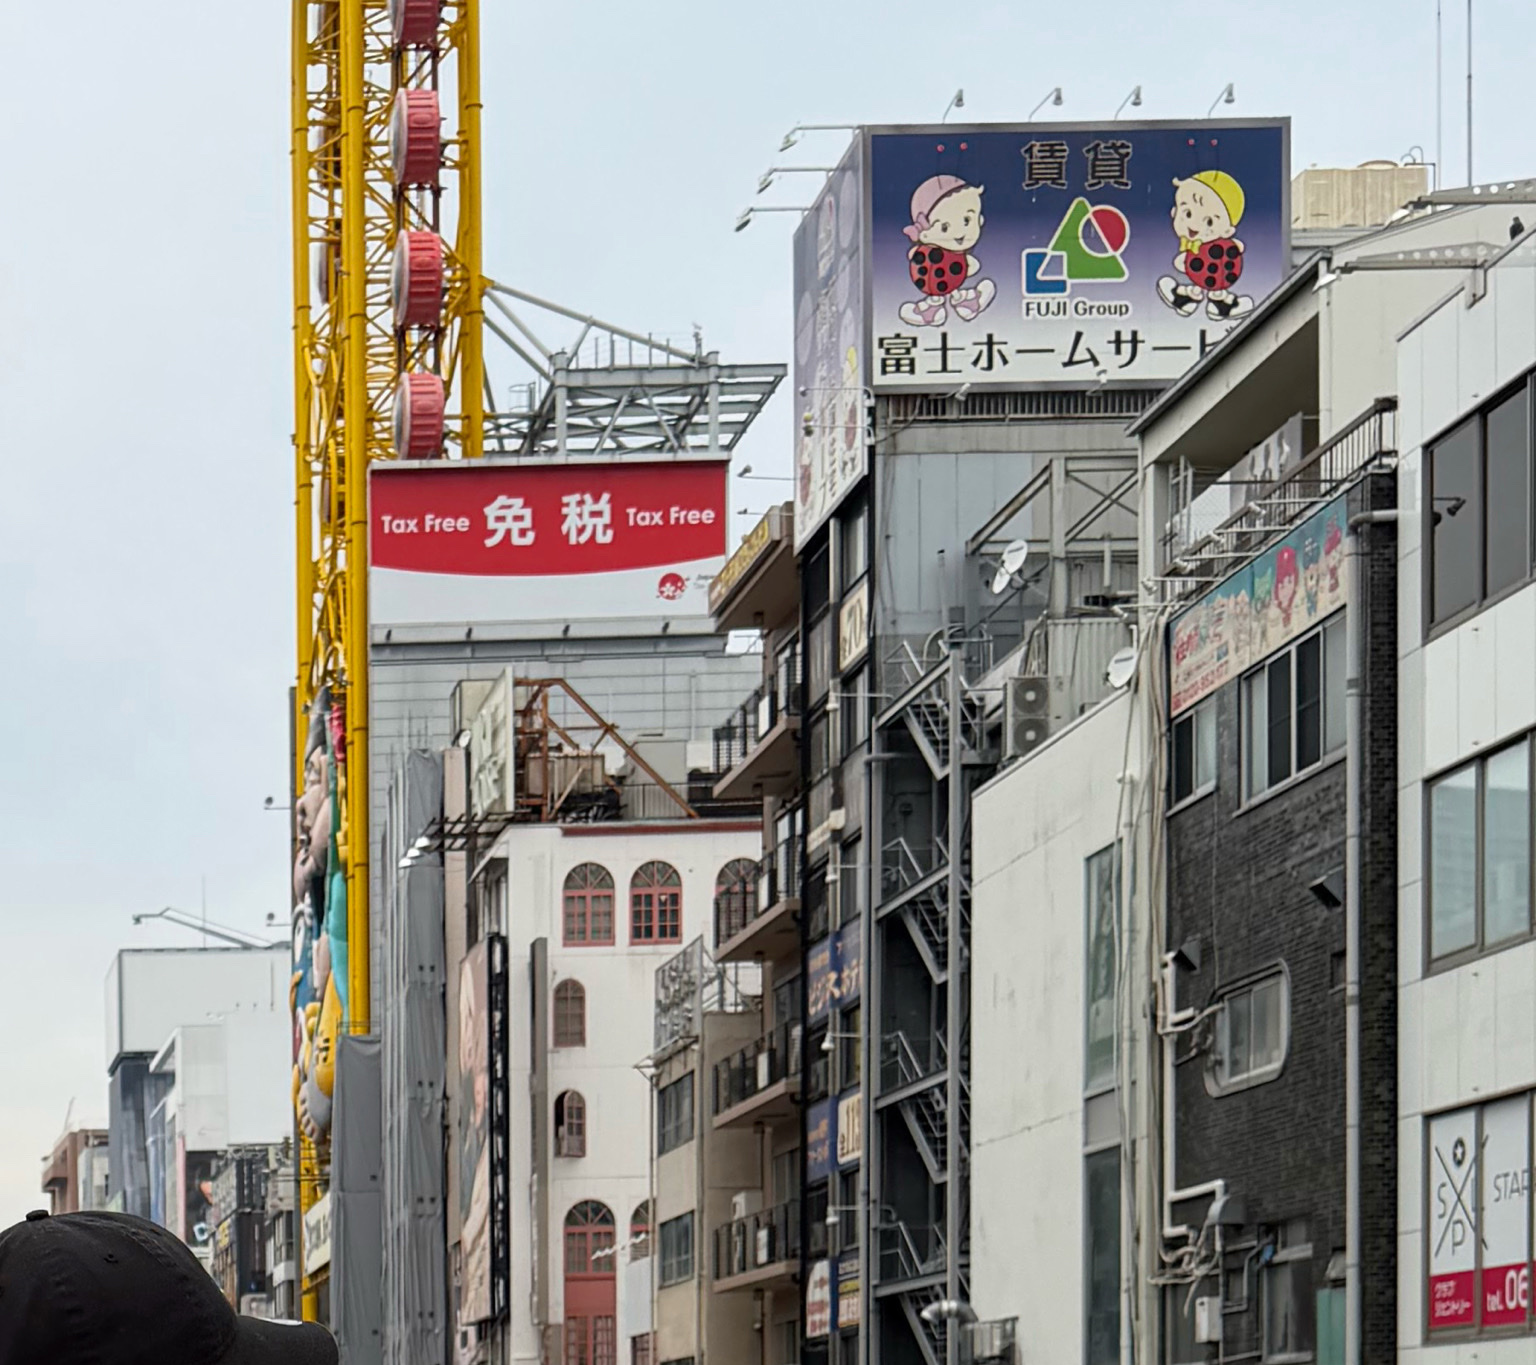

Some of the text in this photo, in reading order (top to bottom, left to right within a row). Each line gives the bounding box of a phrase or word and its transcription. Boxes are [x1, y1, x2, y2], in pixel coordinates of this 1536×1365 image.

[1020, 139, 1132, 191] 賃貸
[1024, 300, 1131, 320] FUJI Group
[381, 513, 471, 534] Tax Free
[482, 491, 614, 549] 免税
[626, 506, 716, 527] Tax Free
